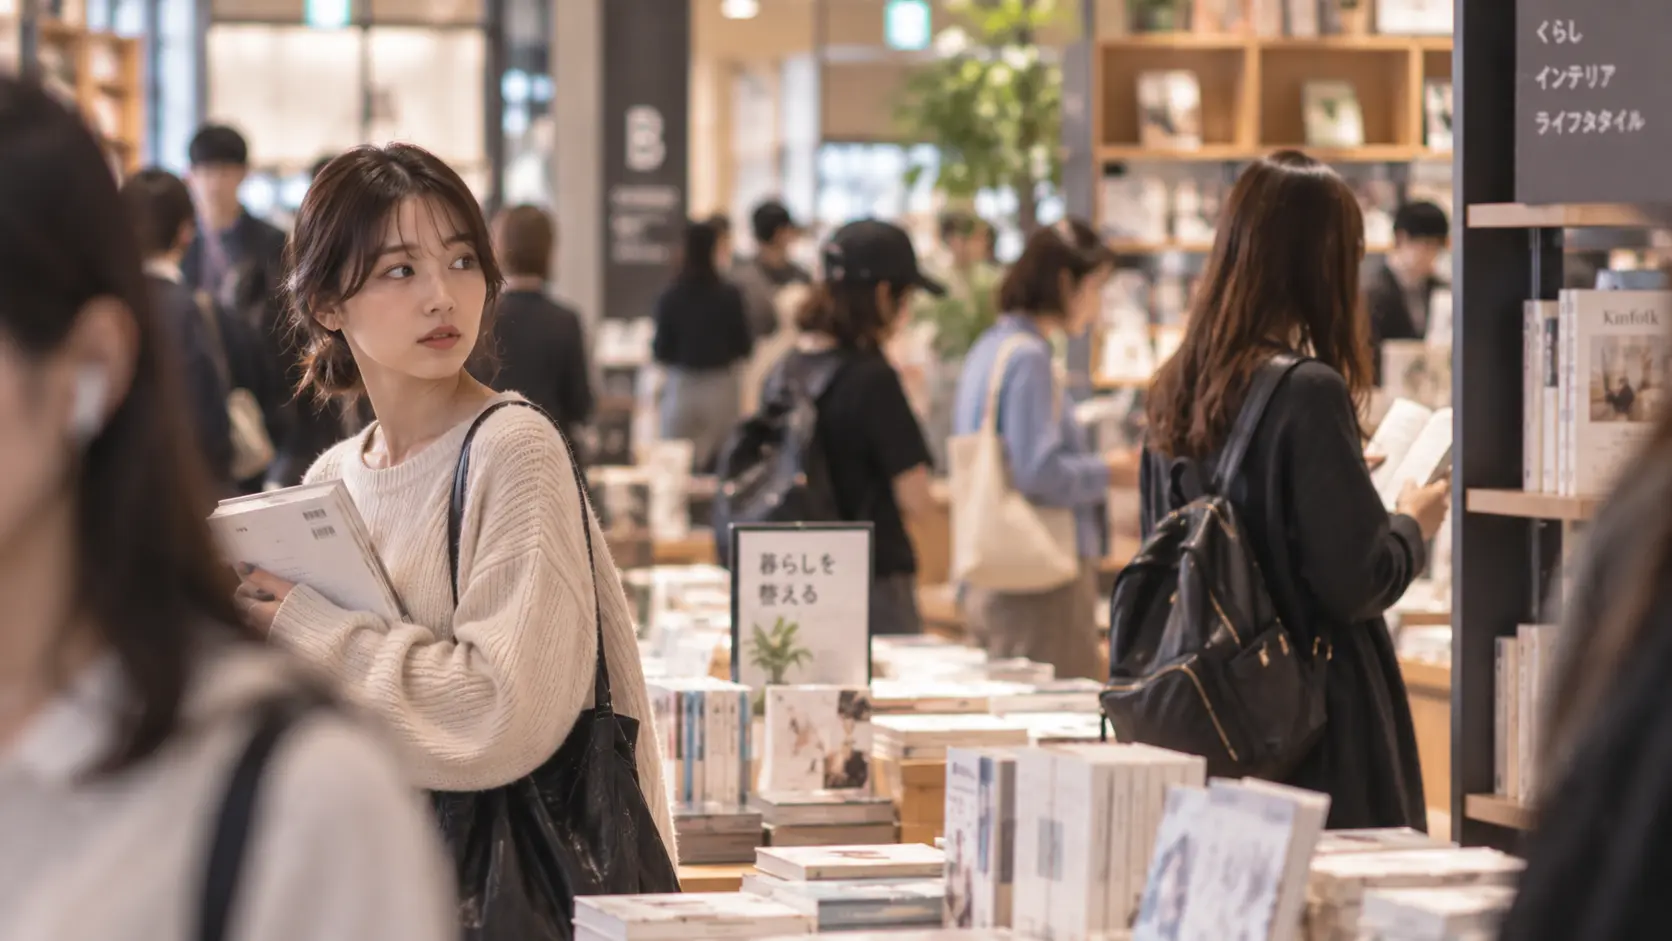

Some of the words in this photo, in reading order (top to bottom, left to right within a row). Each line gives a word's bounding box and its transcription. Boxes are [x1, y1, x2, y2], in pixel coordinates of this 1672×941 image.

[1536, 19, 1583, 44] くらし
[1535, 64, 1616, 90] インテリア
[760, 552, 836, 575] 暮らしを
